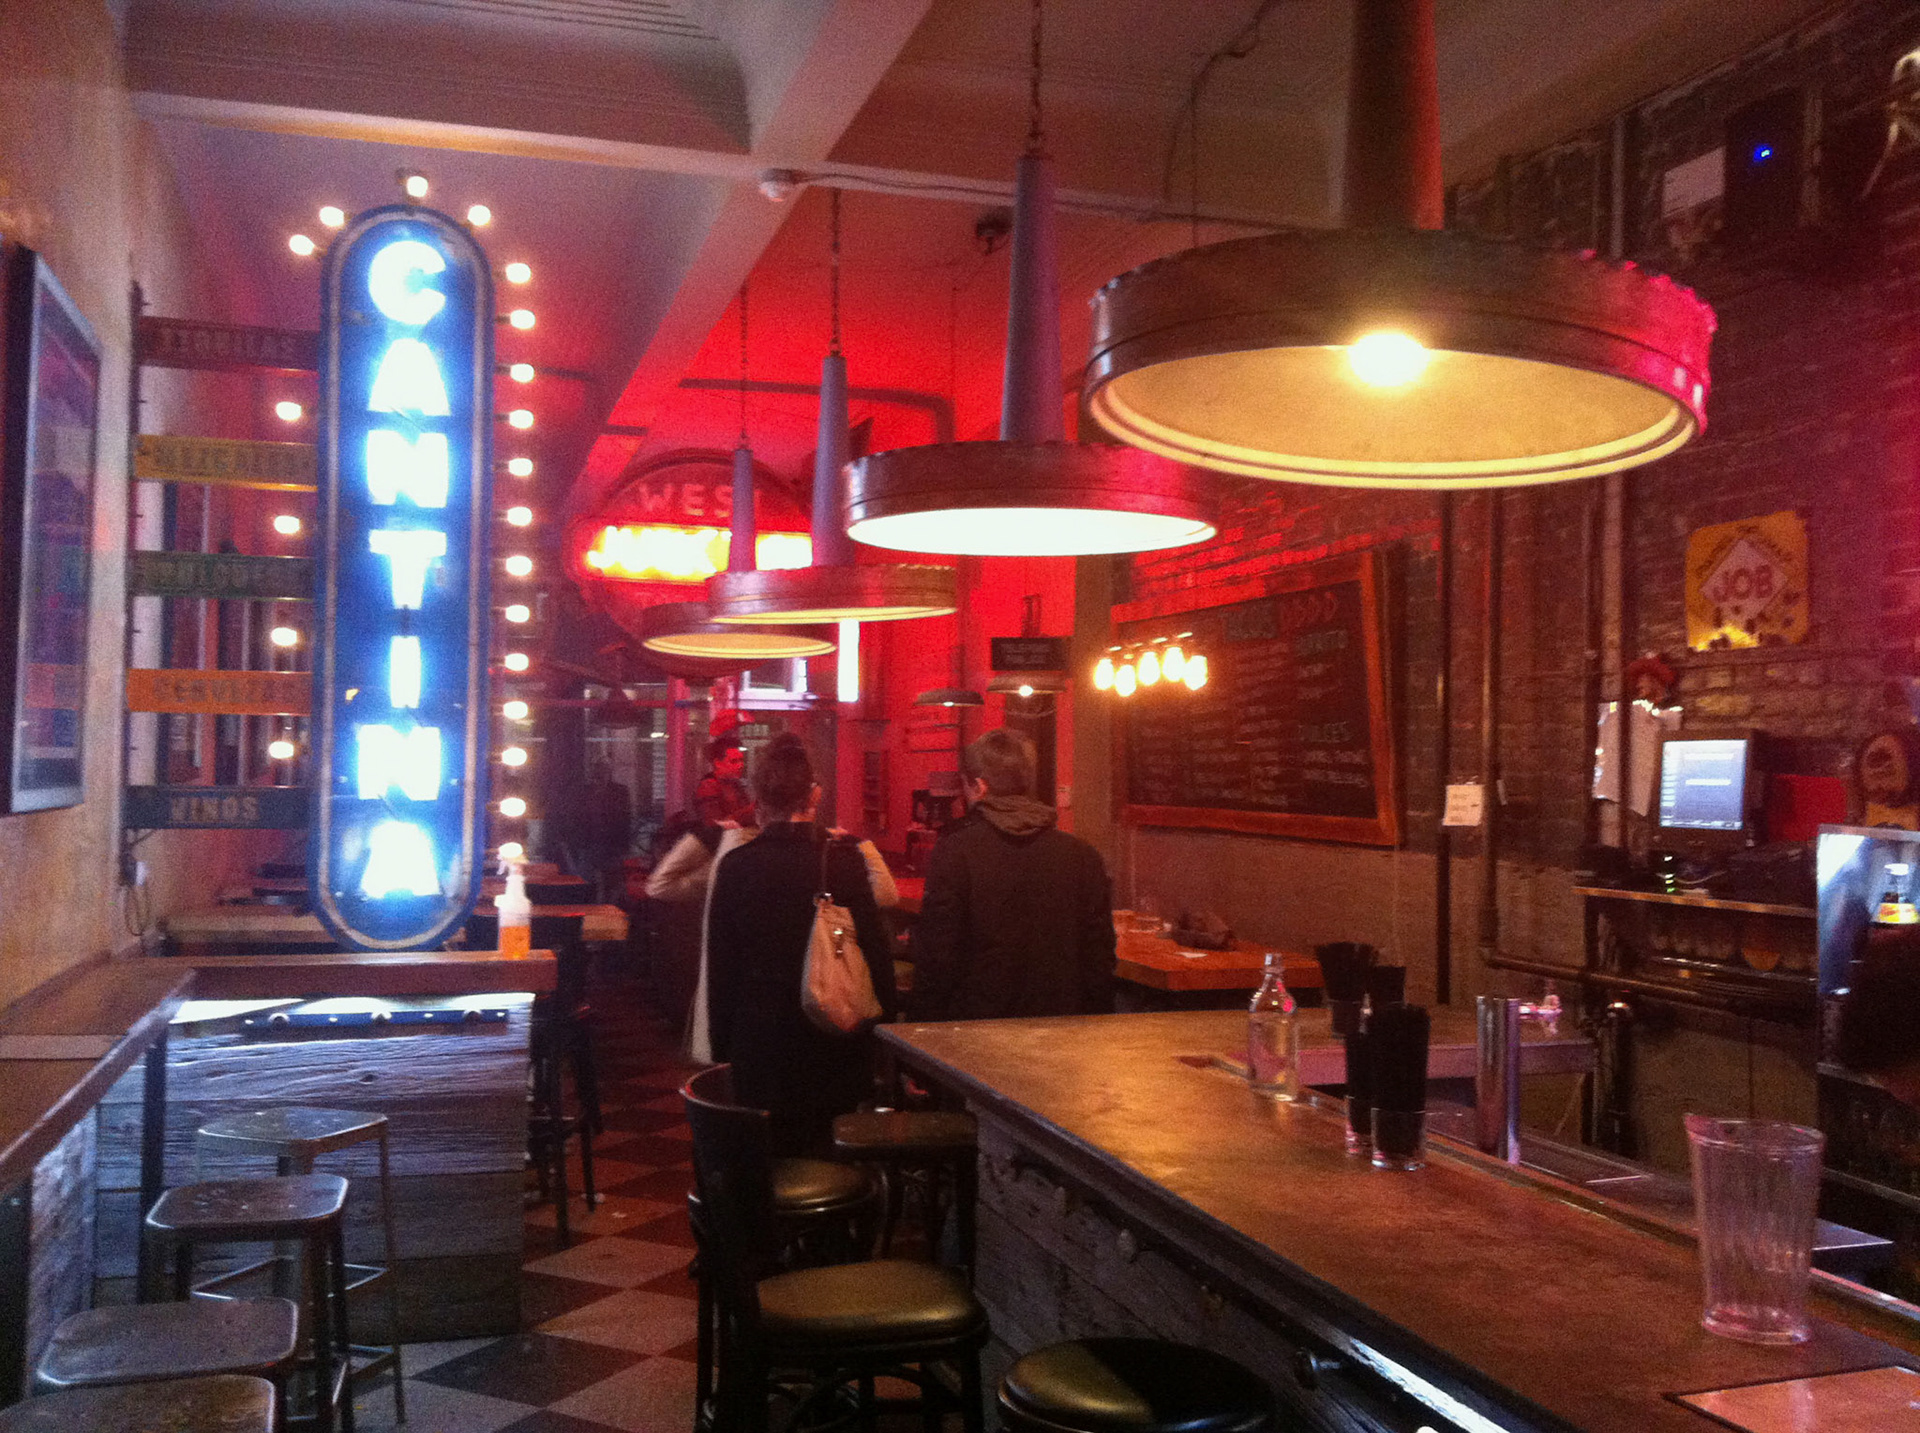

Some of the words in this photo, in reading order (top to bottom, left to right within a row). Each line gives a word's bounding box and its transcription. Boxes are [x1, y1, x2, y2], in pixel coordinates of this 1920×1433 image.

[358, 240, 451, 898] CANTINA
[1713, 564, 1774, 603] JOB
[170, 797, 260, 822] VINOS
